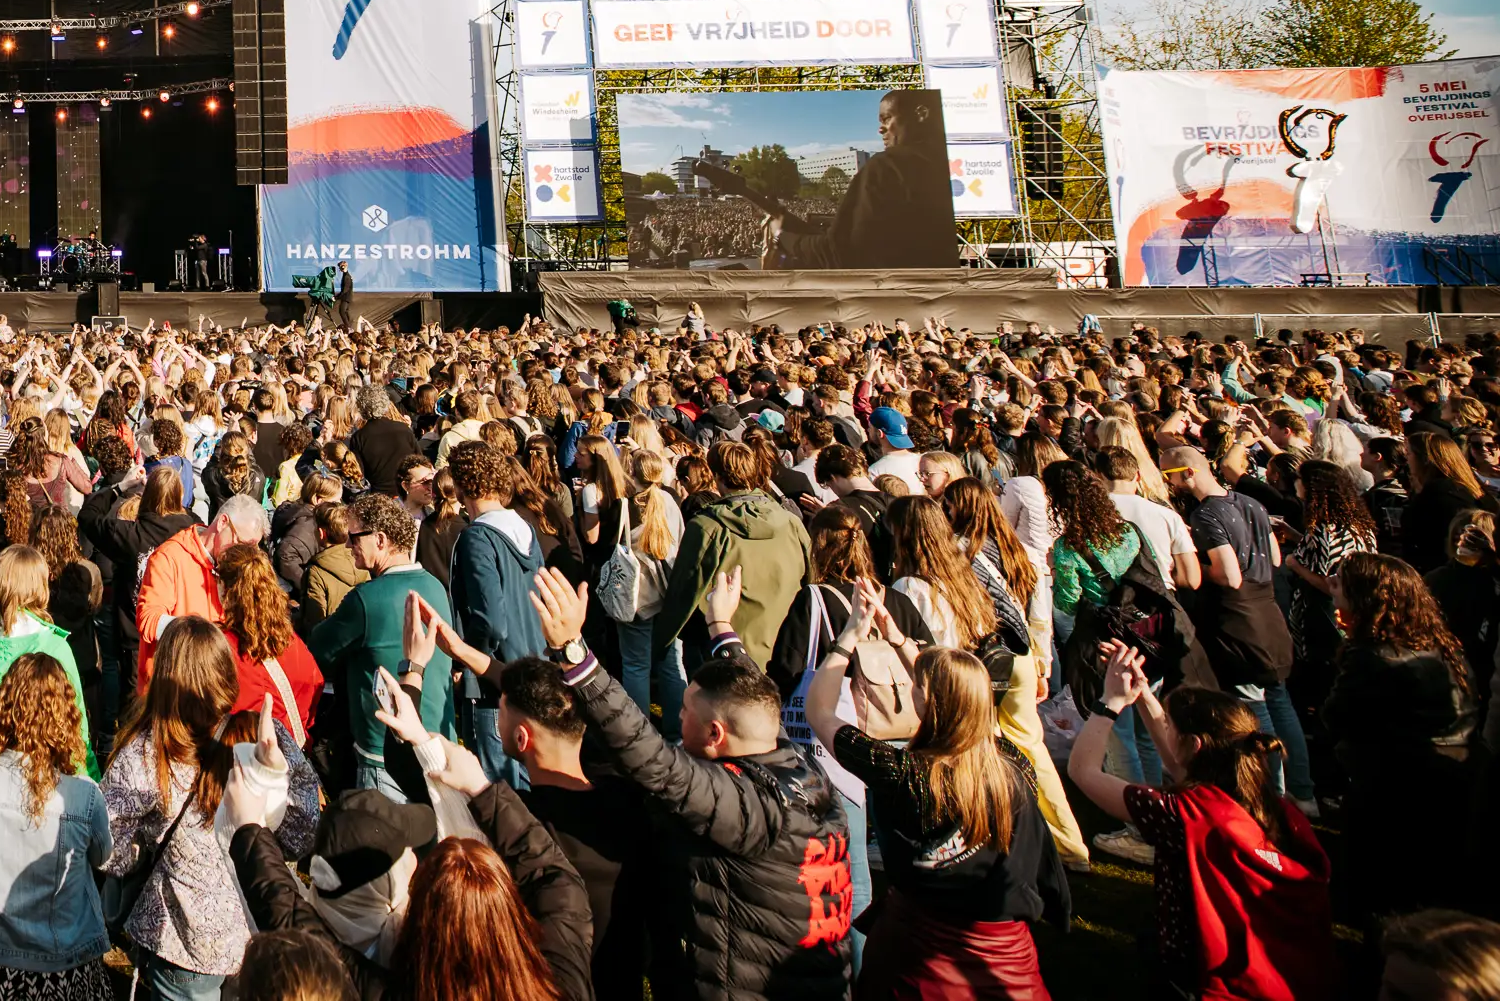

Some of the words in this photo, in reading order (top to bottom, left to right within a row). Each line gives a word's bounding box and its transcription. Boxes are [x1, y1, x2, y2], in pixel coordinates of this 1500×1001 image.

[614, 23, 679, 42] GEEF
[686, 20, 810, 41] VRIJHEID
[816, 18, 892, 38] DOOR
[1419, 83, 1430, 93] 5
[1433, 80, 1467, 92] MEI
[1402, 91, 1491, 104] BEVRIJDINGS
[1415, 102, 1478, 112] FESTIVAL
[1408, 110, 1490, 122] OVERIJSSEL
[1182, 124, 1321, 141] BEVRIJDIGS
[1205, 141, 1291, 156] FESTIVA
[965, 160, 1002, 168] hartstad
[1234, 157, 1277, 165] Overijssel
[554, 173, 583, 181] Zwolle
[966, 168, 994, 176] Zwolle
[286, 243, 472, 260] HANZESTROHM
[792, 696, 804, 708] SEE
